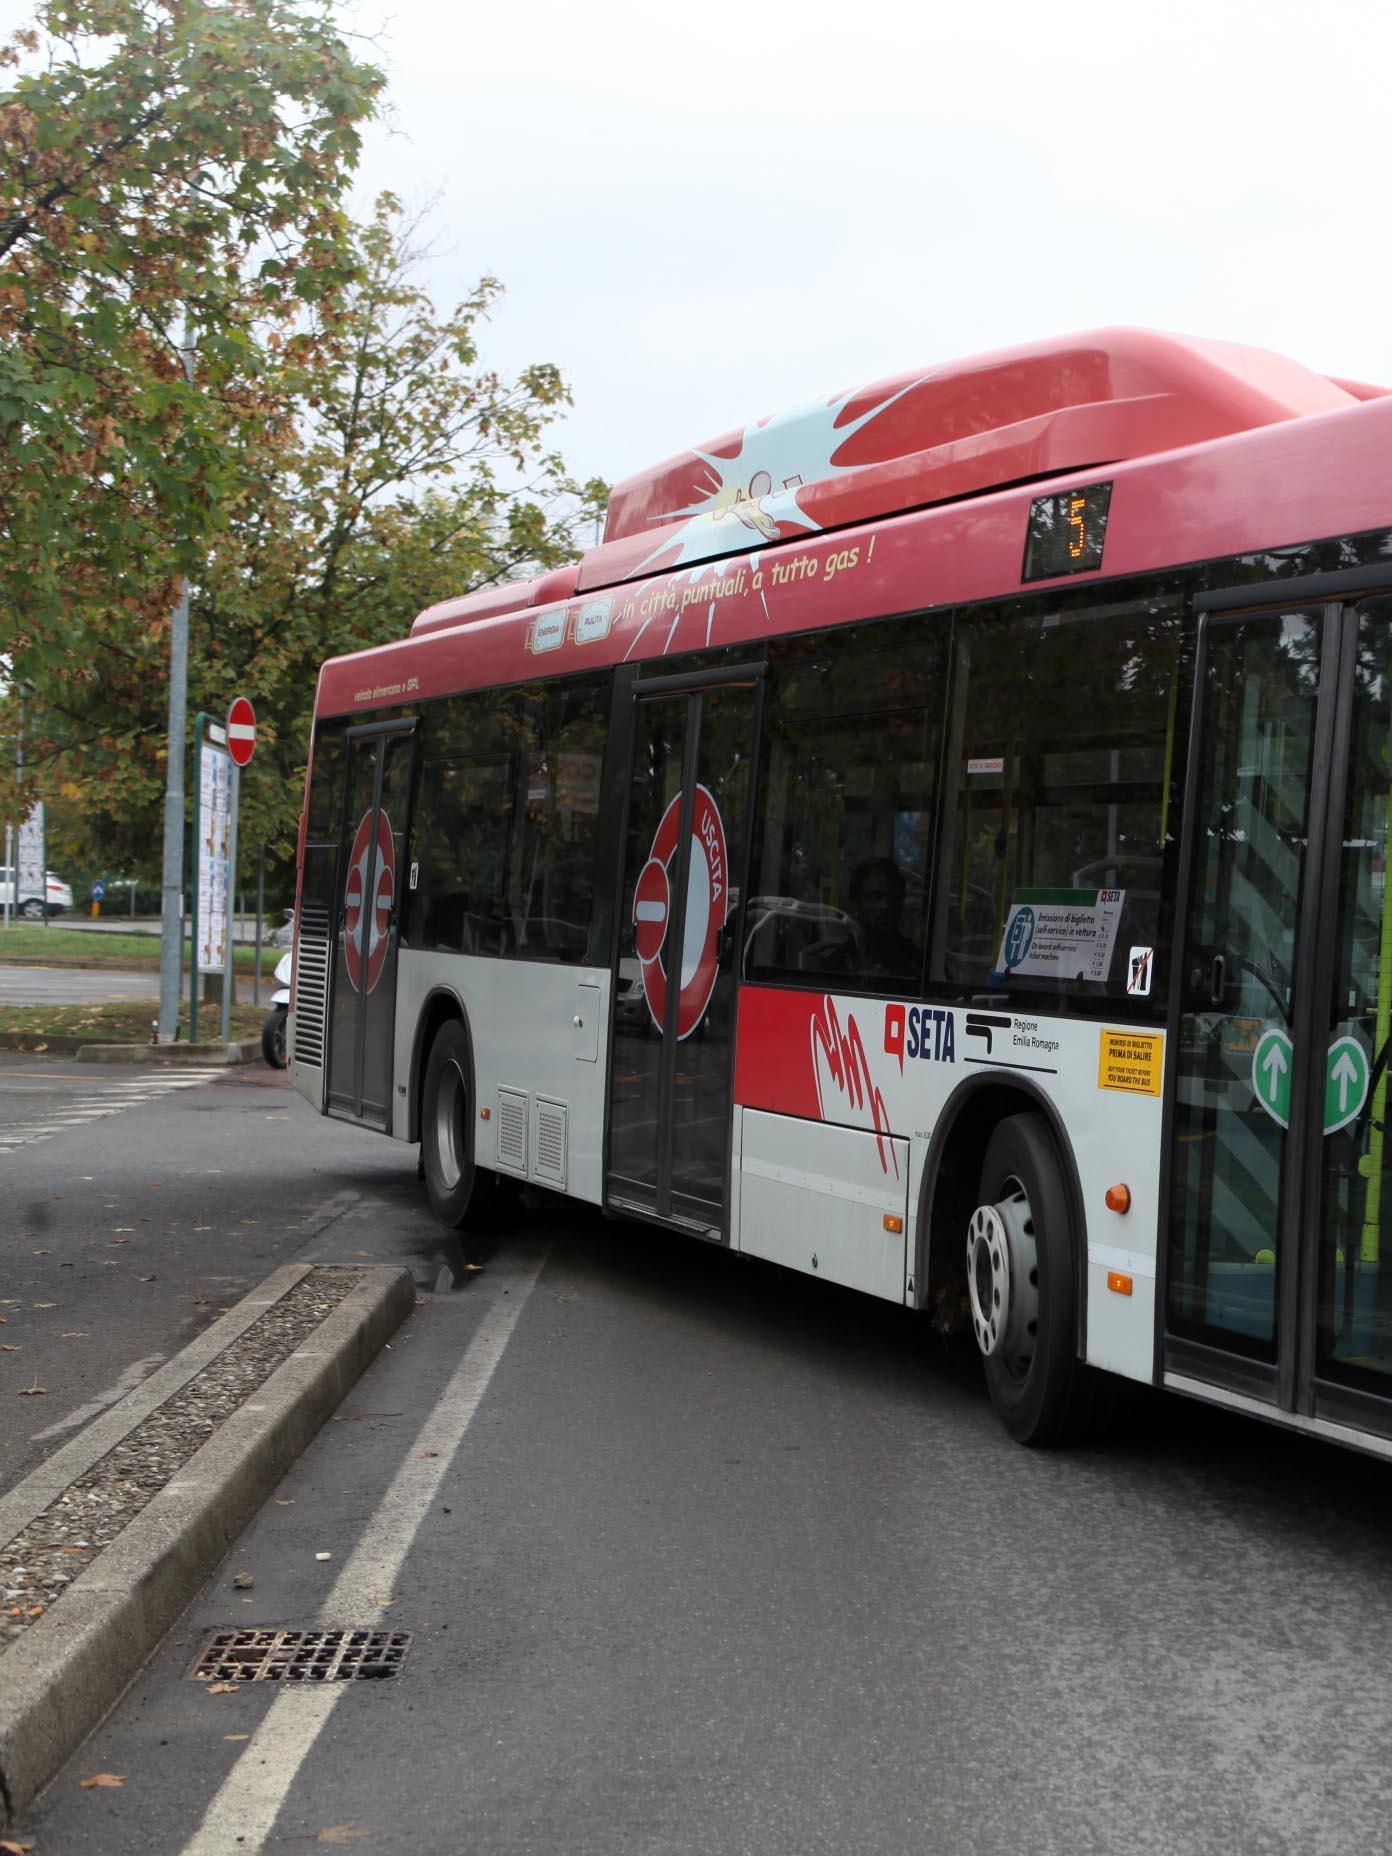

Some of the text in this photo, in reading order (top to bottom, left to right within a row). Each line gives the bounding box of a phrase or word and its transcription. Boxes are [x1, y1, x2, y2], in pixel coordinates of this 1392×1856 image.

[1069, 499, 1085, 557] 5
[622, 599, 635, 621] in
[752, 570, 763, 590] a
[772, 559, 818, 586] tutto
[824, 547, 860, 582] gas
[867, 535, 876, 564] !
[538, 625, 559, 637] ENERGIA
[702, 808, 723, 902] USCITA
[1106, 890, 1120, 903] SETA
[1038, 912, 1095, 926] Emissione di biglietto
[1069, 927, 1075, 936] in
[1076, 928, 1097, 937] vettura
[1013, 1018, 1038, 1032] Regione
[907, 1006, 955, 1063] SETA
[1013, 1034, 1060, 1052] Emilia Romagna
[1132, 1040, 1153, 1050] BIGLIETTO
[1109, 1048, 1152, 1061] PRIMA DI SALIRE
[1116, 1074, 1132, 1084] BOARD
[1132, 1076, 1141, 1085] THE
[1141, 1077, 1151, 1087] BUS
